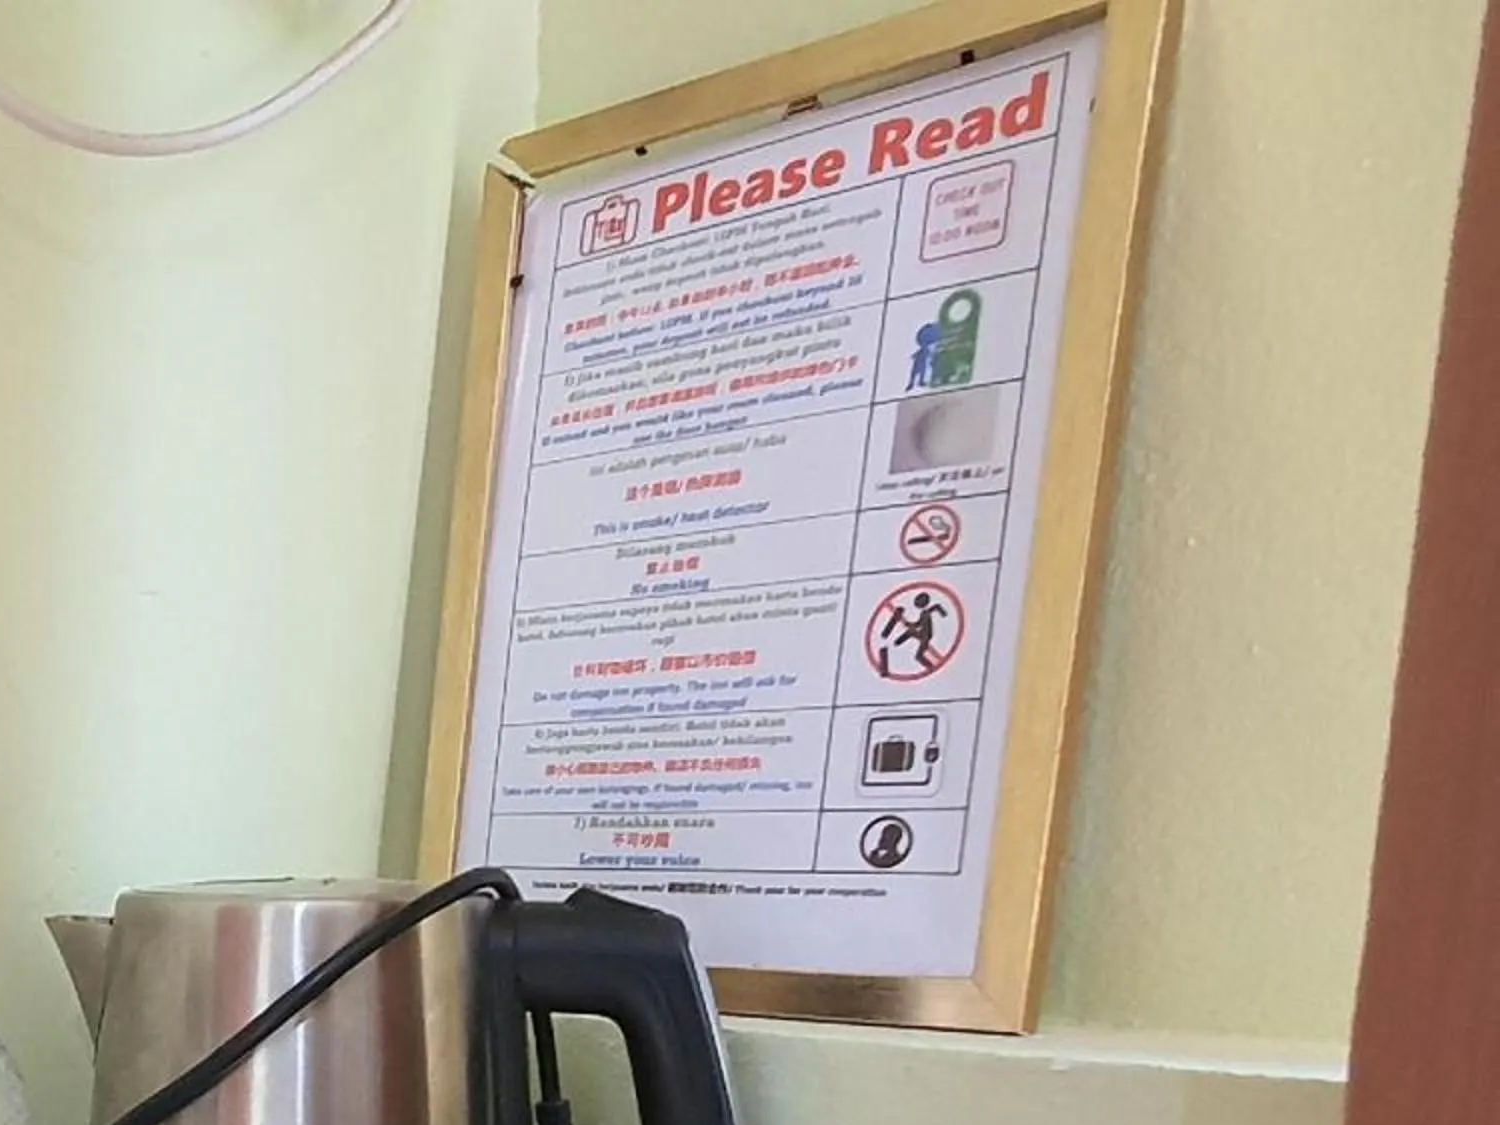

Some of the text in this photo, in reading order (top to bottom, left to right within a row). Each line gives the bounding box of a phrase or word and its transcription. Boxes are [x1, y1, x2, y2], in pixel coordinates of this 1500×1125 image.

[652, 71, 1050, 233] Please Read
[591, 522, 617, 535] This
[712, 500, 771, 518] detector
[629, 574, 710, 597] No smoking
[588, 815, 671, 827] Rendahkan
[672, 816, 716, 827] suara
[577, 851, 702, 869] Lower your voice
